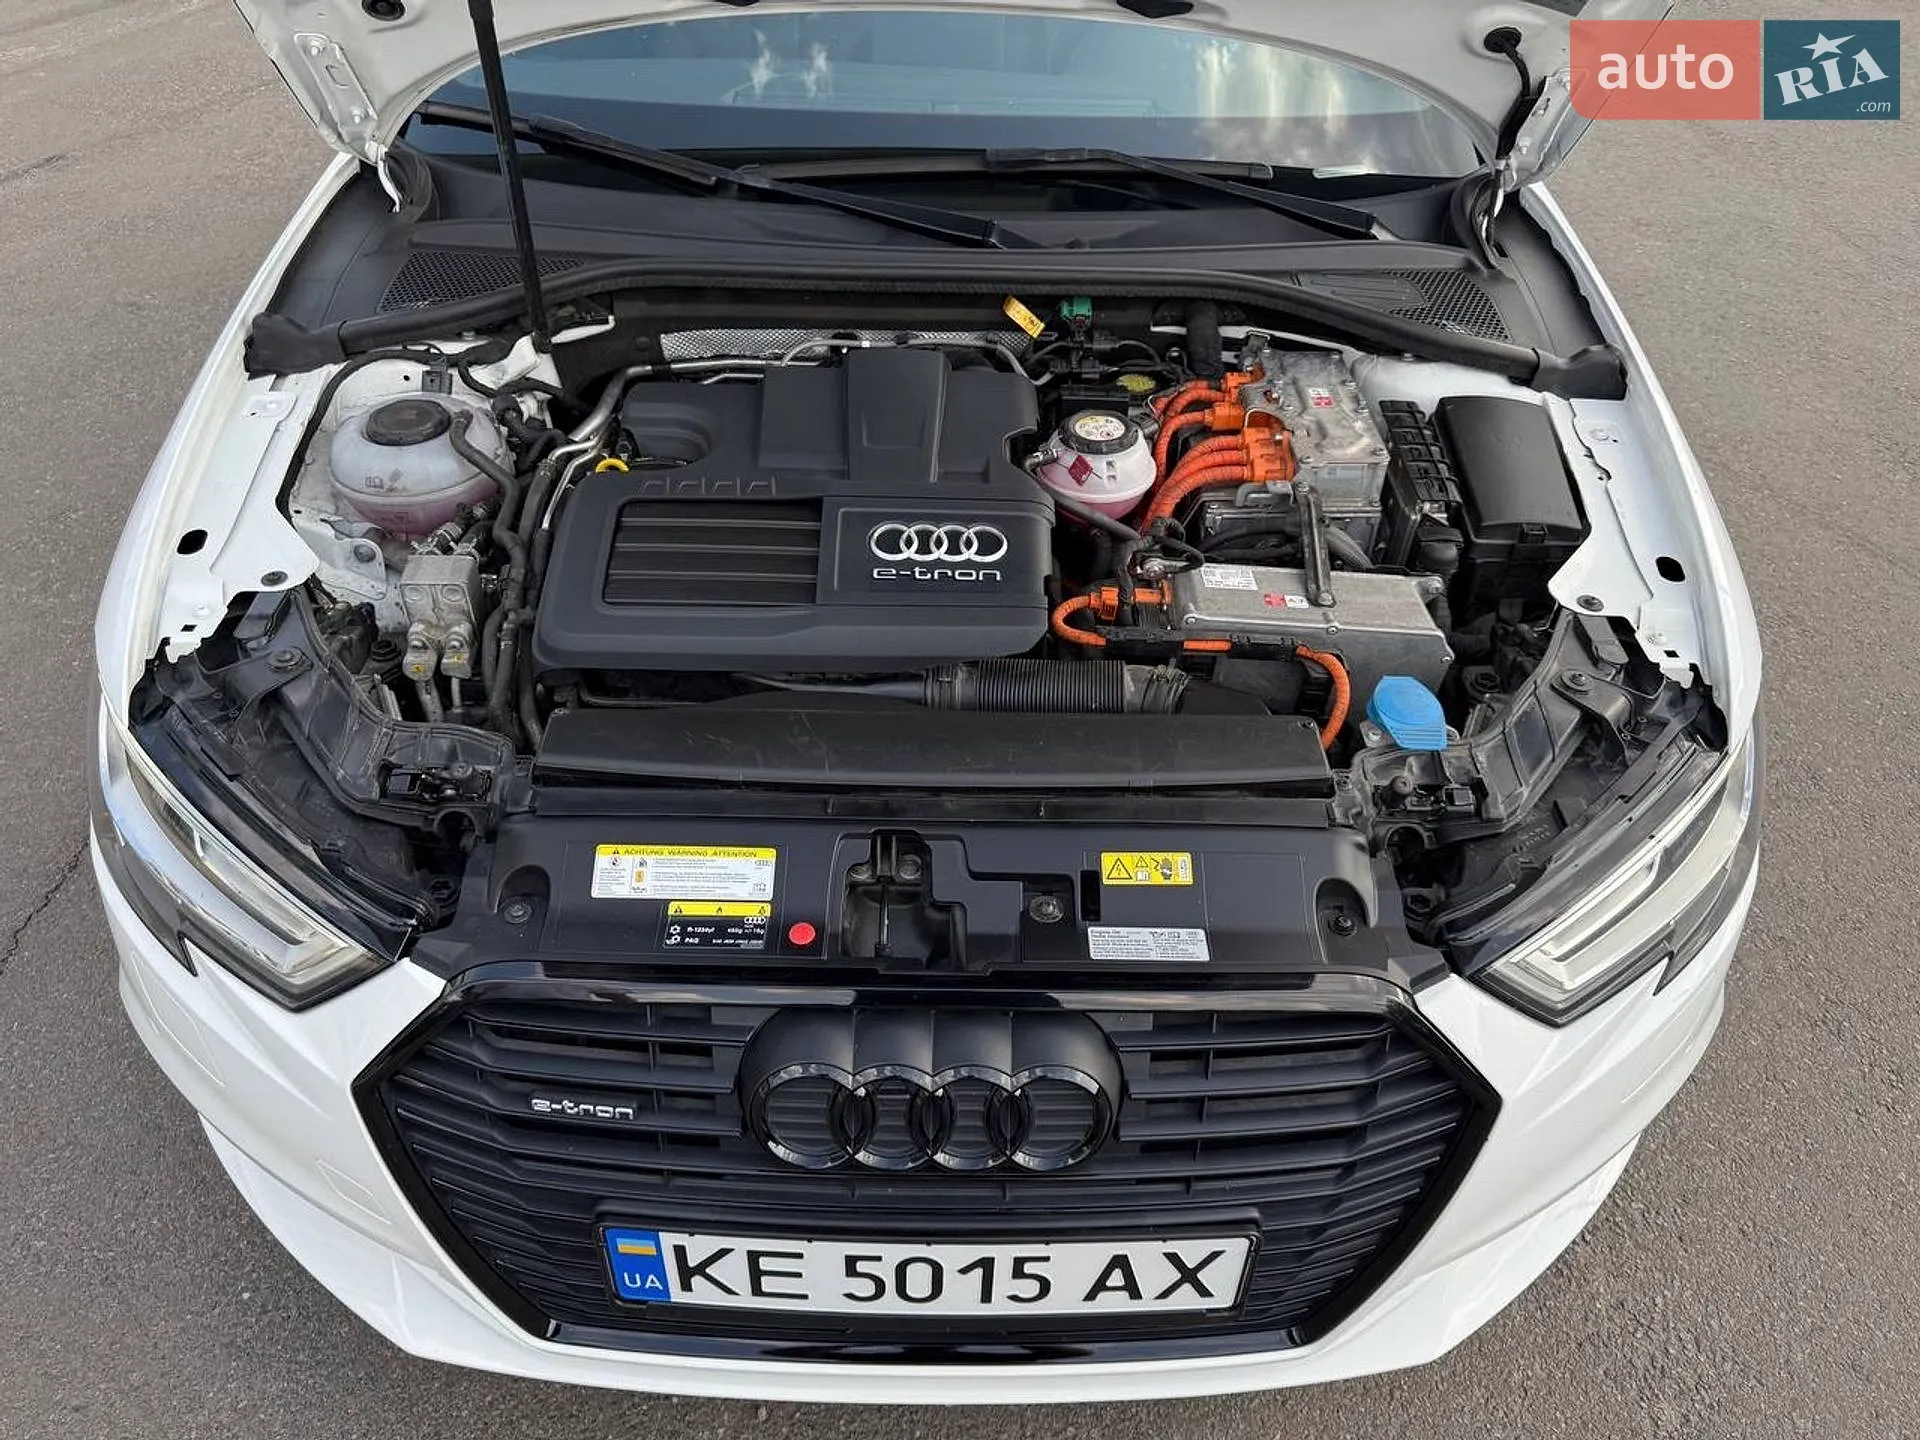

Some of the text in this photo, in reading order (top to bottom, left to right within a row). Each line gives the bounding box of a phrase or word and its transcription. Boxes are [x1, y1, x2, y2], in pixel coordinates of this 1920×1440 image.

[873, 566, 1001, 581] e-tron
[624, 849, 664, 857] ACHTUNG
[531, 1099, 634, 1121] e-tron
[623, 1271, 664, 1291] UA
[672, 1244, 1227, 1305] KE 5015 AX
